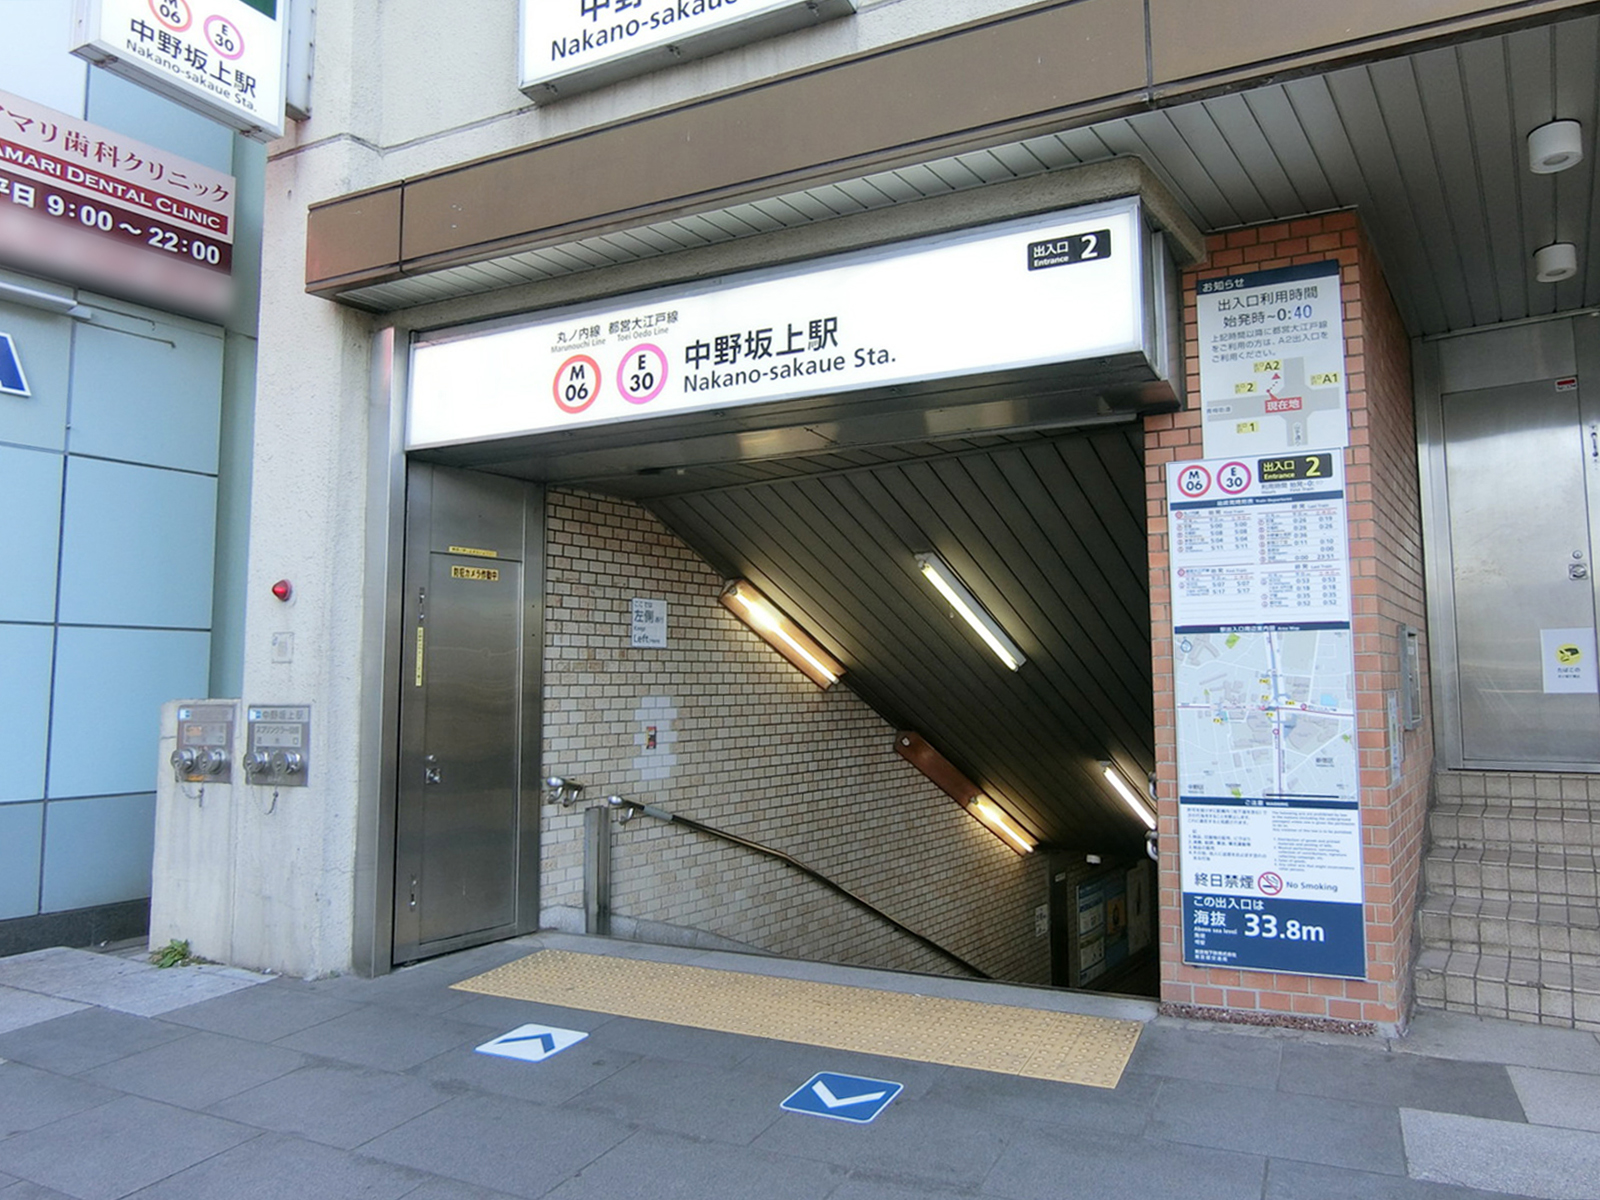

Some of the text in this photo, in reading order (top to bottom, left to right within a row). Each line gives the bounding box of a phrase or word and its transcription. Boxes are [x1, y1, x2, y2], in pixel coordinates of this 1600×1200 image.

[160, 4, 181, 24] 06
[221, 24, 229, 36] E
[214, 33, 234, 52] 30
[131, 19, 256, 98] 中野坂上駅
[126, 39, 257, 113] Nakano-sakaue Sta.
[0, 105, 229, 202] マリ歯科クリニック
[66, 165, 153, 206] DENTAL
[156, 199, 221, 229] CLINIC
[1033, 234, 1098, 260] 出入口 2
[1033, 256, 1069, 267] Entrance
[1202, 278, 1245, 292] お知らせ
[1218, 286, 1318, 312] 出入口利用時間
[556, 310, 679, 344] 丸ノ内線 都営大江戸線
[617, 333, 632, 342] Toei
[633, 329, 652, 340] Oedo
[654, 326, 669, 335] Line
[684, 317, 838, 371] 中野坂上駅
[638, 354, 646, 370] E
[684, 347, 896, 393] Nakano-sakaue Sta.
[1264, 361, 1280, 371] A2
[570, 366, 585, 381] M
[1322, 373, 1338, 384] A1
[629, 372, 654, 392] 30
[1247, 383, 1254, 392] 2
[565, 384, 589, 402] 06
[1267, 399, 1300, 411] 現在地
[1250, 423, 1255, 432] 1
[1231, 467, 1237, 476] E
[1263, 456, 1321, 477] 出入口 2
[1188, 471, 1200, 480] M
[1226, 477, 1243, 488] 30
[1263, 472, 1295, 480] Entrance
[1186, 481, 1203, 491] 06
[1194, 872, 1254, 890] 終日禁煙
[1286, 881, 1338, 892] No Smoking
[1193, 896, 1264, 910] この出入口は
[1193, 910, 1324, 942] 海抜 33.8m
